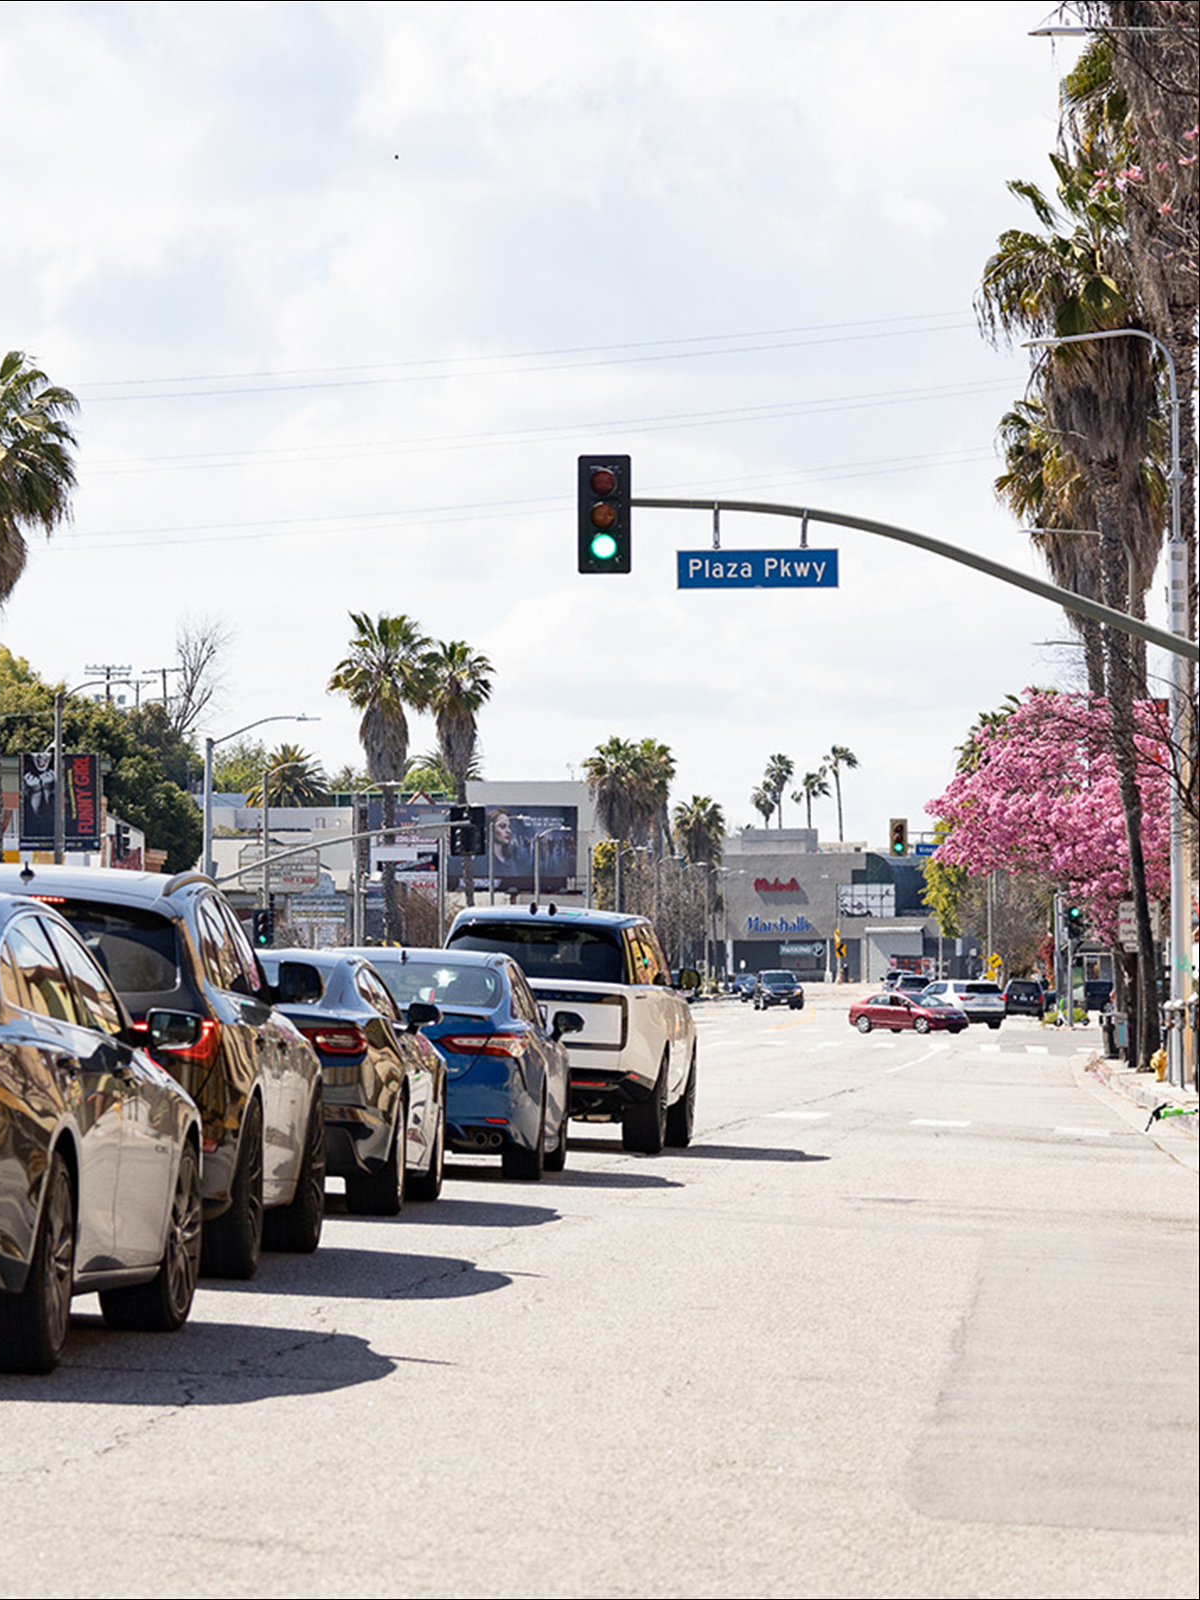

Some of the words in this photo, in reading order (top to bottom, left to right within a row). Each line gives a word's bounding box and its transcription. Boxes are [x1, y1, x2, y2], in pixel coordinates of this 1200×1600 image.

[688, 558, 752, 579] Plaza
[764, 557, 826, 582] Pkwy
[73, 755, 91, 787] GIRL
[75, 788, 95, 834] FUNNY
[742, 915, 812, 932] Marshalls
